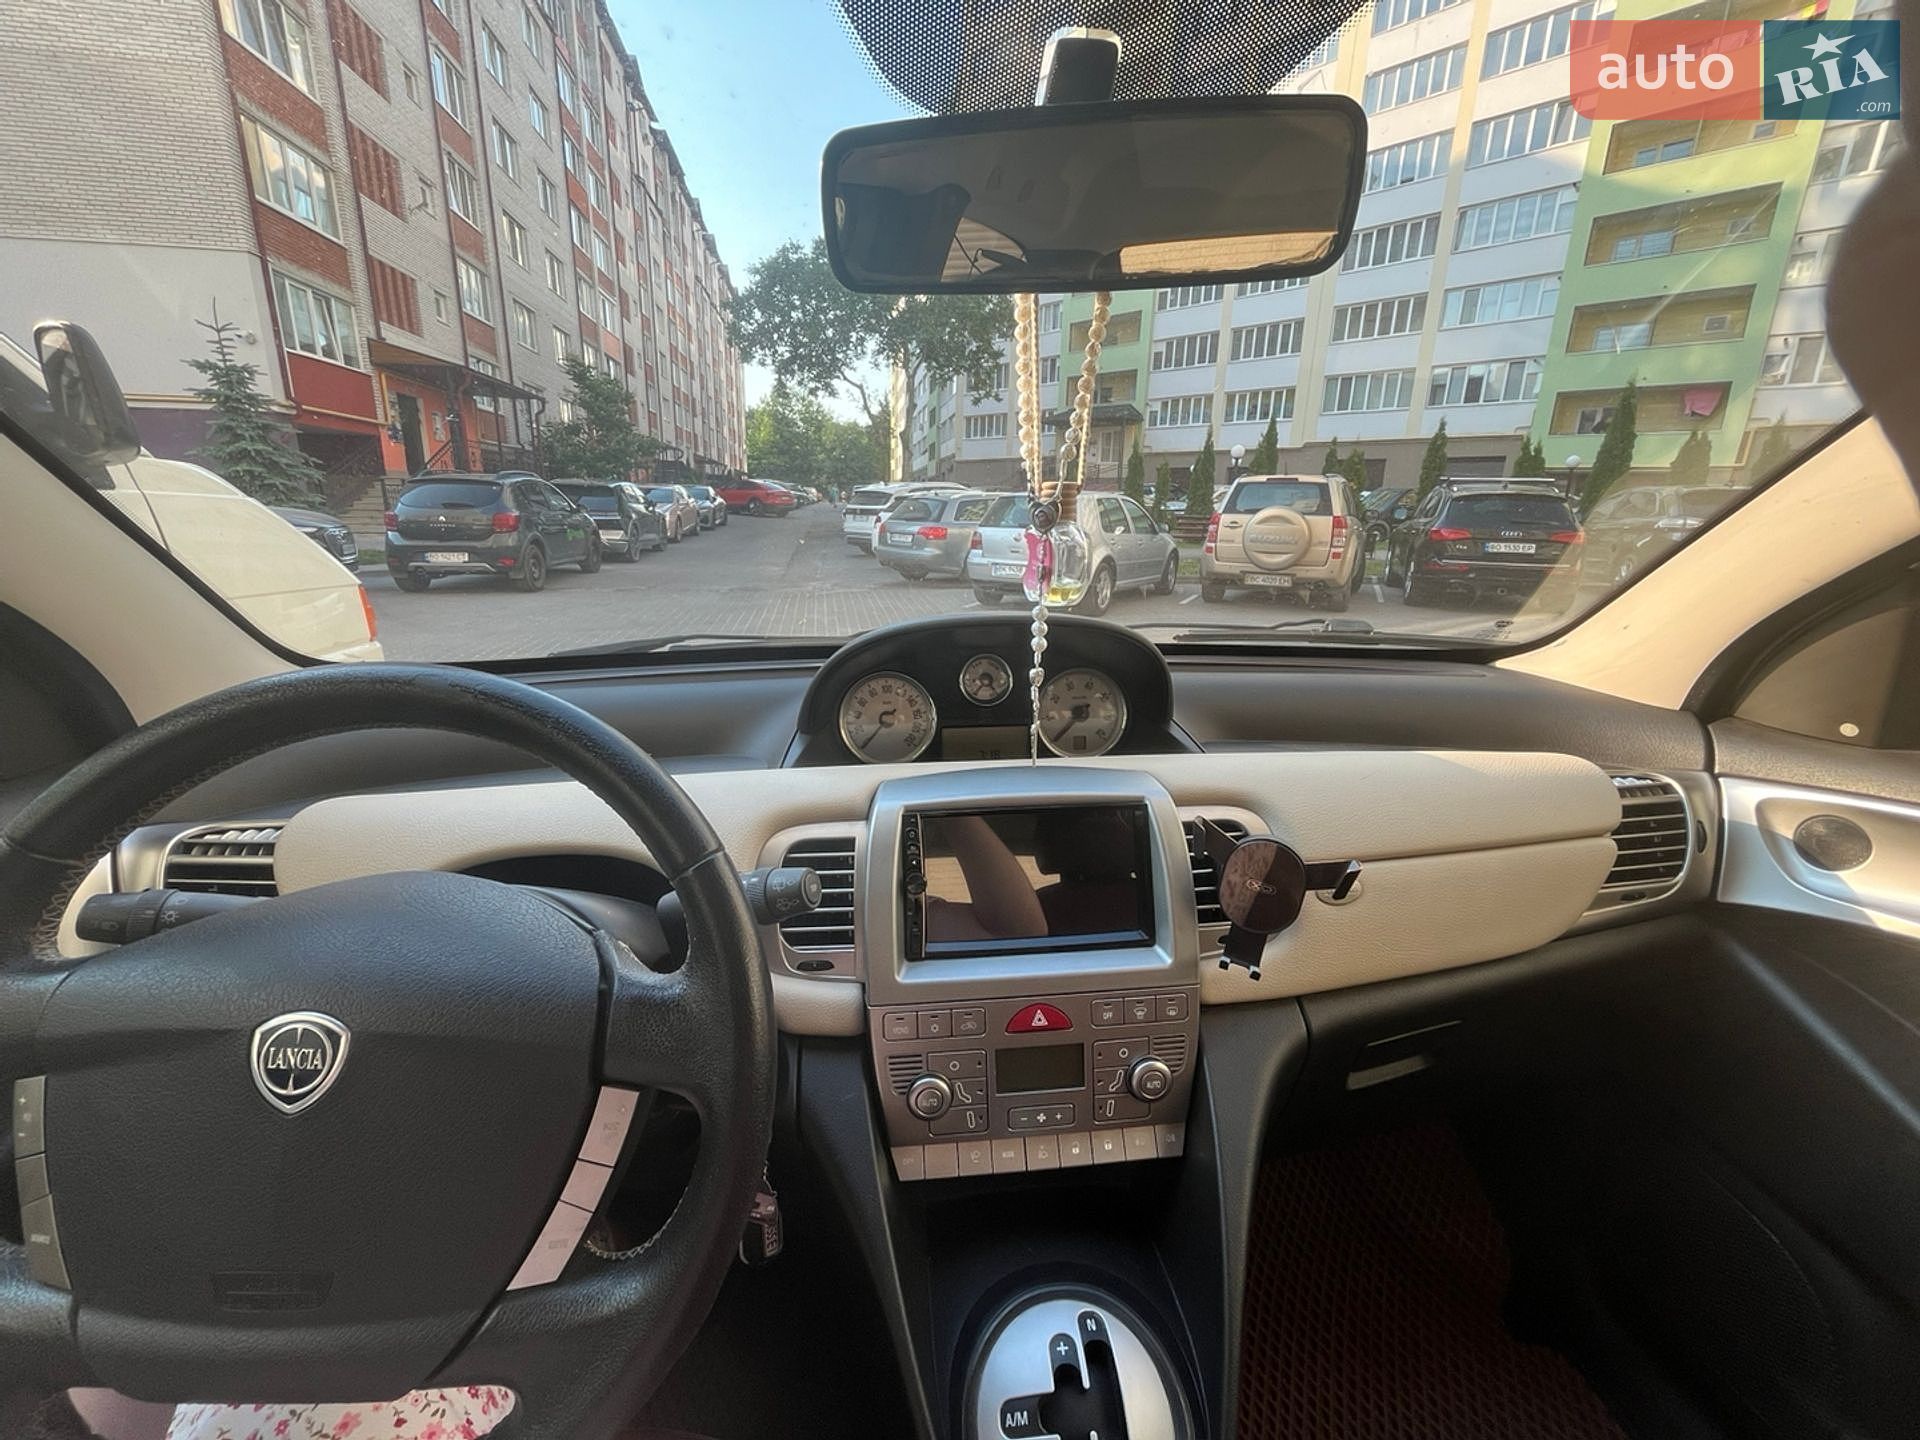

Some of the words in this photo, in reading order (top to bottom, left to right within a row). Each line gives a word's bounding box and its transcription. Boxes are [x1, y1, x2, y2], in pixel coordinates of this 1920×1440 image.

[267, 1047, 323, 1071] LANCIA
[1086, 1318, 1096, 1332] N
[1005, 1410, 1029, 1428] A/M
